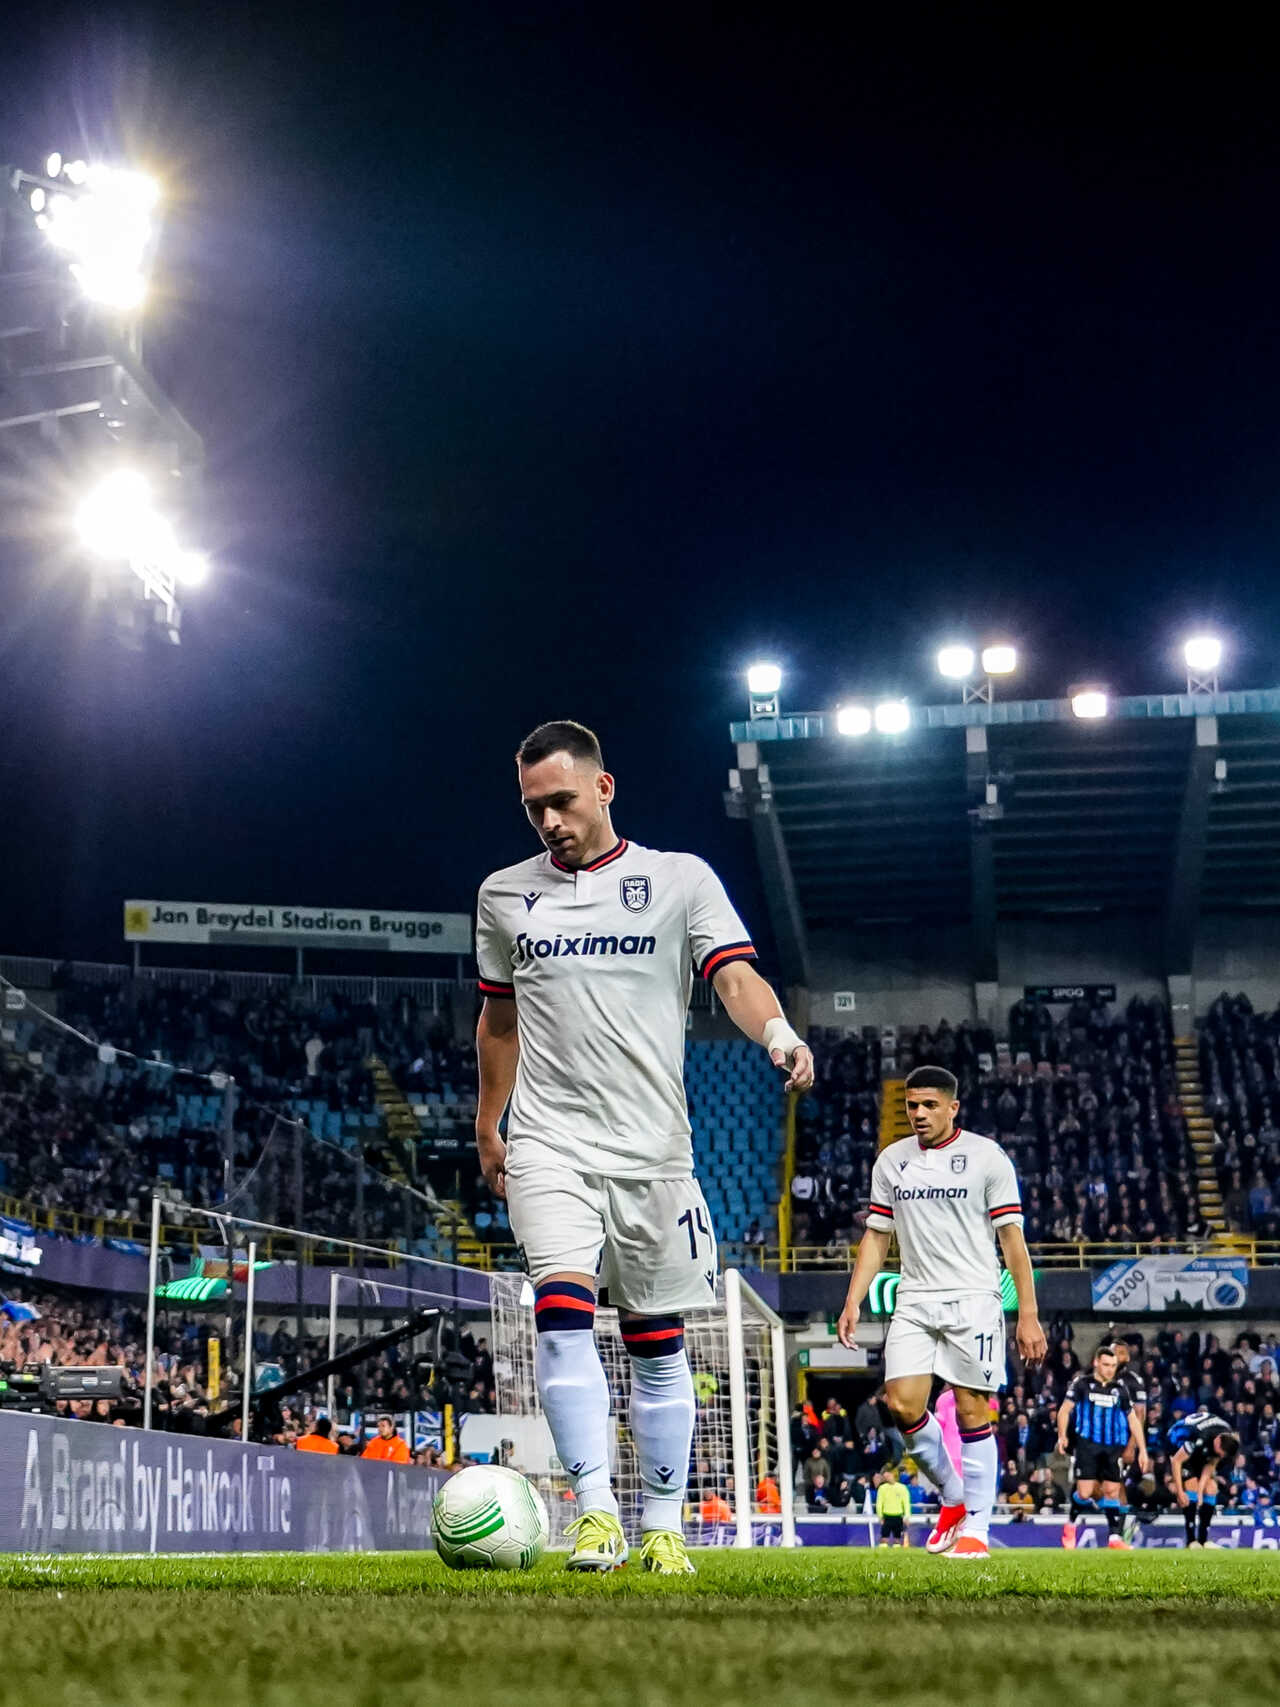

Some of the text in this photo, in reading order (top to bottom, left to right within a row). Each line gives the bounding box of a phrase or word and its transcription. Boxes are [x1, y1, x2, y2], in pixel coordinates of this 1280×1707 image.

[152, 906, 443, 938] Jan Breydel Stadion Brugge
[515, 932, 656, 962] Stoiximan
[893, 1184, 968, 1202] Stoiximan
[1107, 1269, 1146, 1307] 8200
[974, 1332, 994, 1363] 11
[20, 1428, 292, 1554] A Brand by Hankook Tire
[1128, 1528, 1241, 1550] rad
[1252, 1528, 1280, 1549] b
